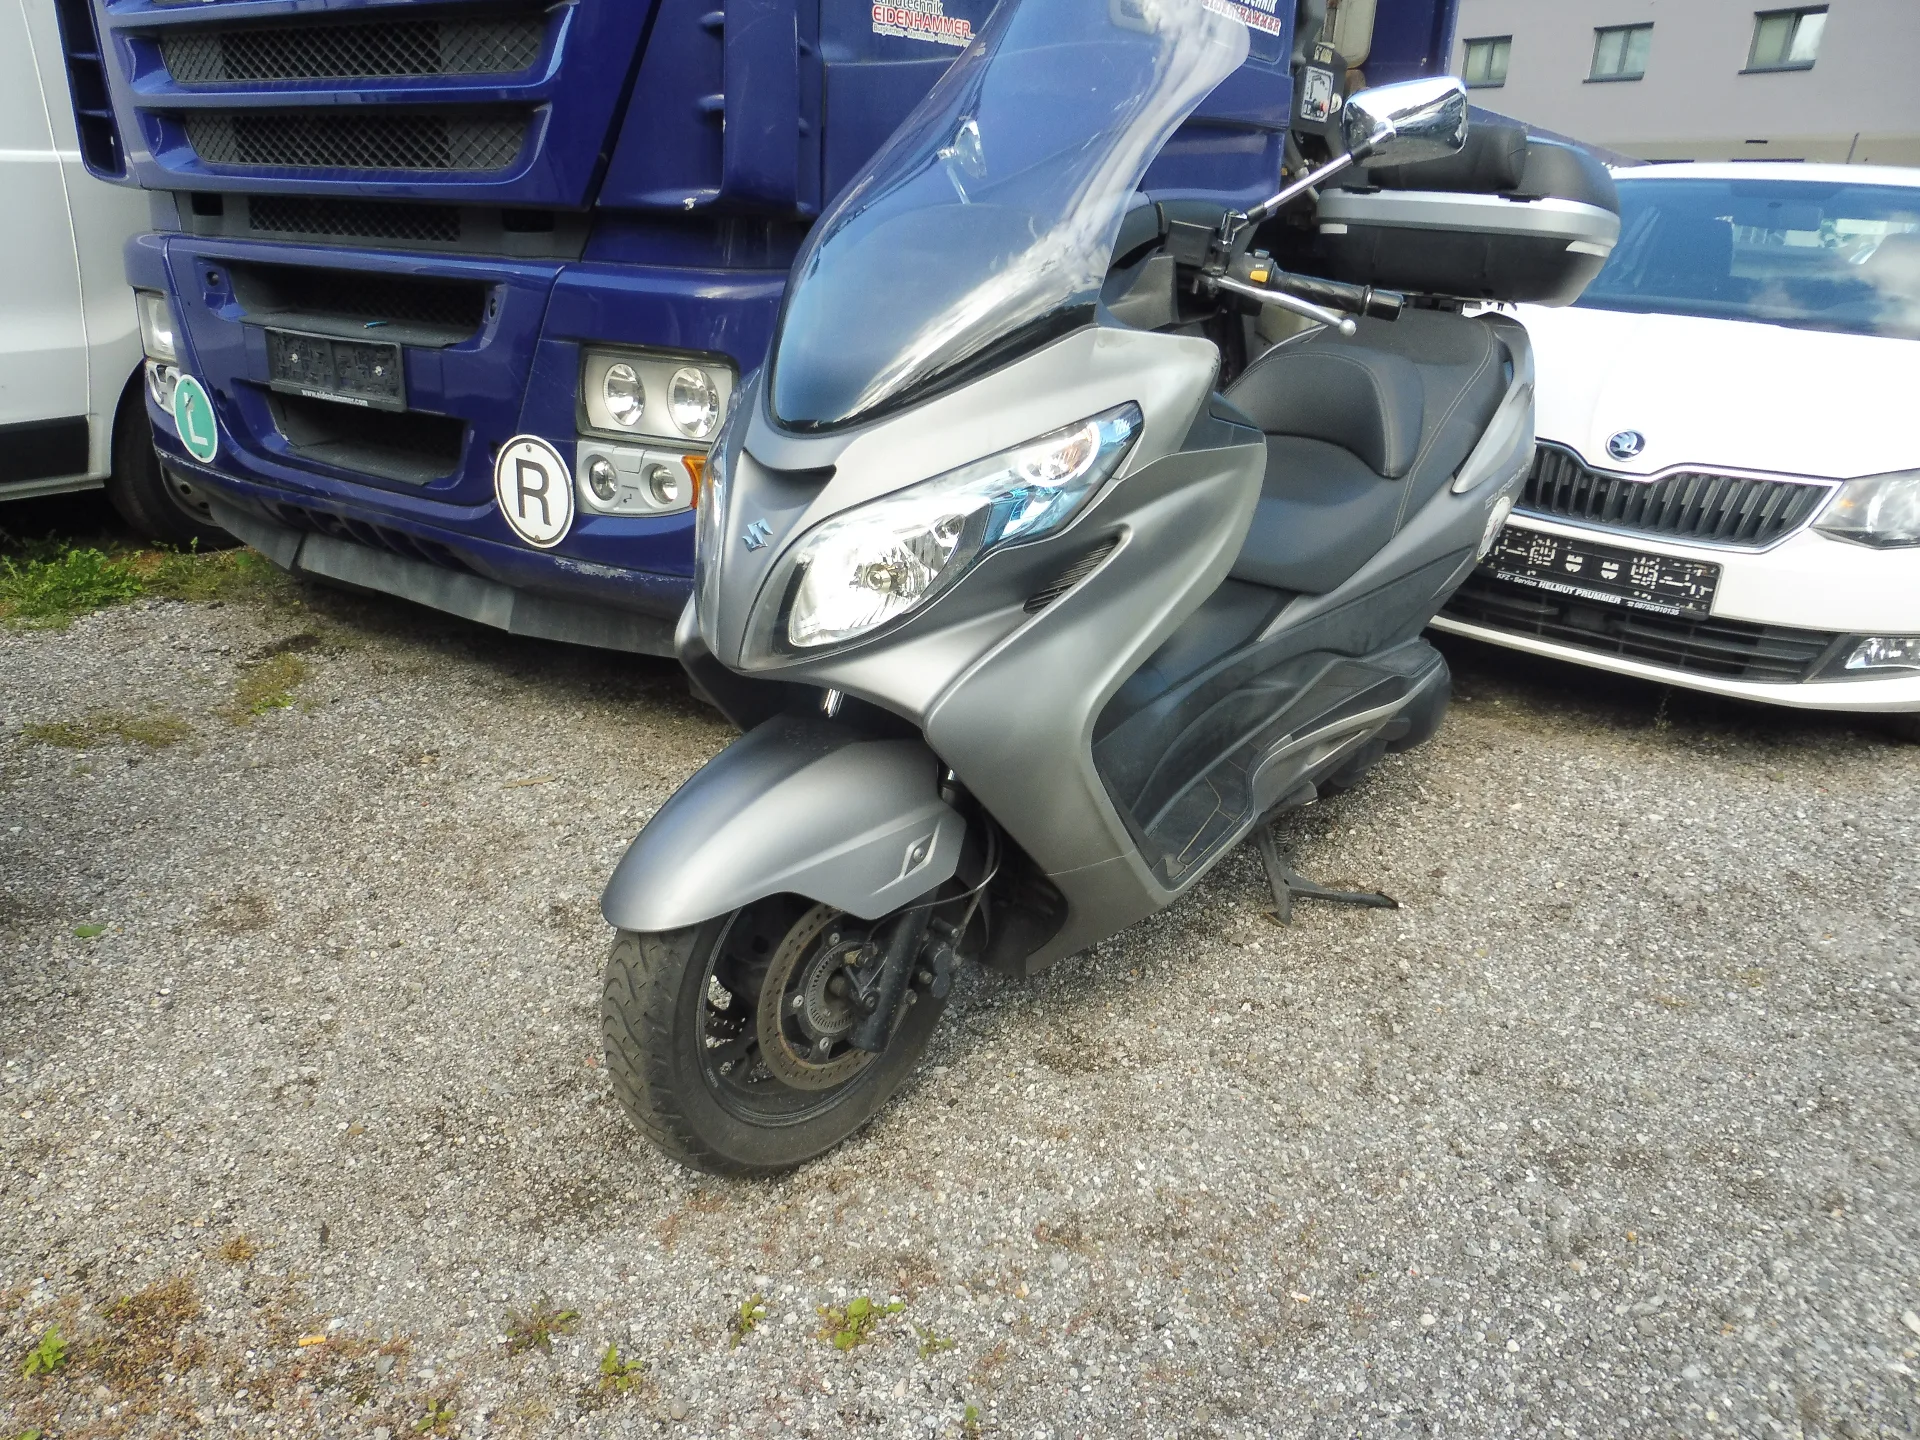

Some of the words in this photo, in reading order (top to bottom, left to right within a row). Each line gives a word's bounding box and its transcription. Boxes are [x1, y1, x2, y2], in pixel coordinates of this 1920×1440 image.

[873, 6, 970, 36] EIDENHAMMER
[184, 392, 208, 445] L
[515, 458, 552, 526] R
[1496, 572, 1510, 580] KFZ
[1513, 576, 1537, 586] Service
[1537, 580, 1577, 595] HELMUT
